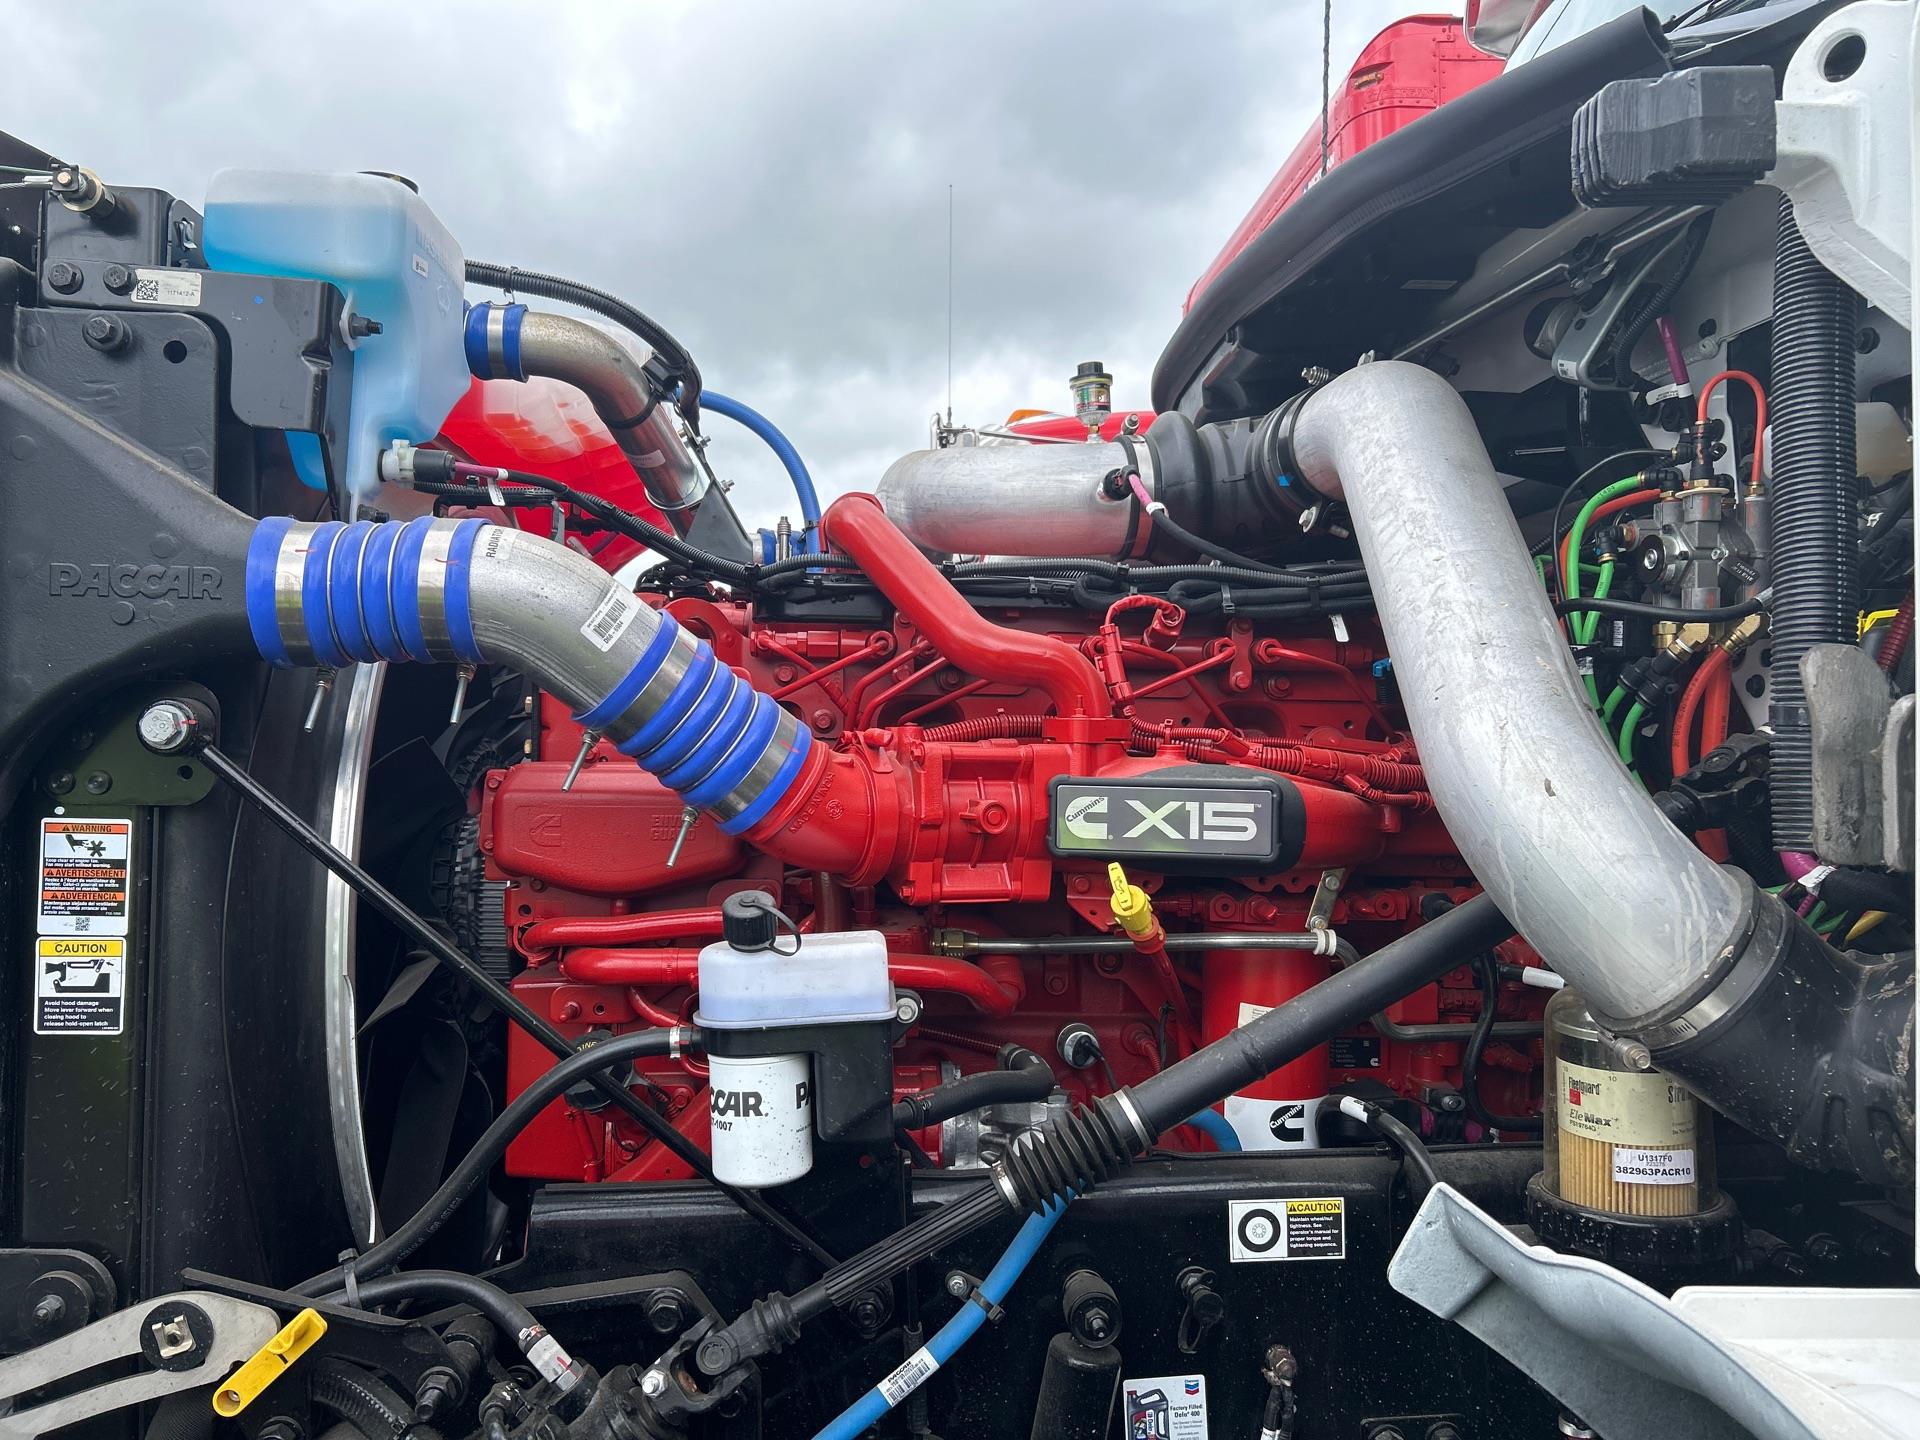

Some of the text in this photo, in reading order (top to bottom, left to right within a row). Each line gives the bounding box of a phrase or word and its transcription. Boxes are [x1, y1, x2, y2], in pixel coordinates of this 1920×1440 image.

[485, 528, 504, 558] RADIATO
[49, 562, 222, 600] PACCAR
[1066, 796, 1258, 842] Cummins X15
[71, 825, 112, 833] WARNING
[55, 869, 124, 878] AVERTISSEMENT
[60, 892, 117, 900] ADVERTENCIA
[54, 943, 107, 953] CAUTION
[1568, 1076, 1600, 1096] Fleetguard
[1269, 1104, 1303, 1129] Cummins
[711, 1118, 733, 1132] -1007
[1638, 1154, 1673, 1162] U1317F0
[1615, 1165, 1691, 1177] 382963PACR10
[1297, 1202, 1340, 1212] CAUTION
